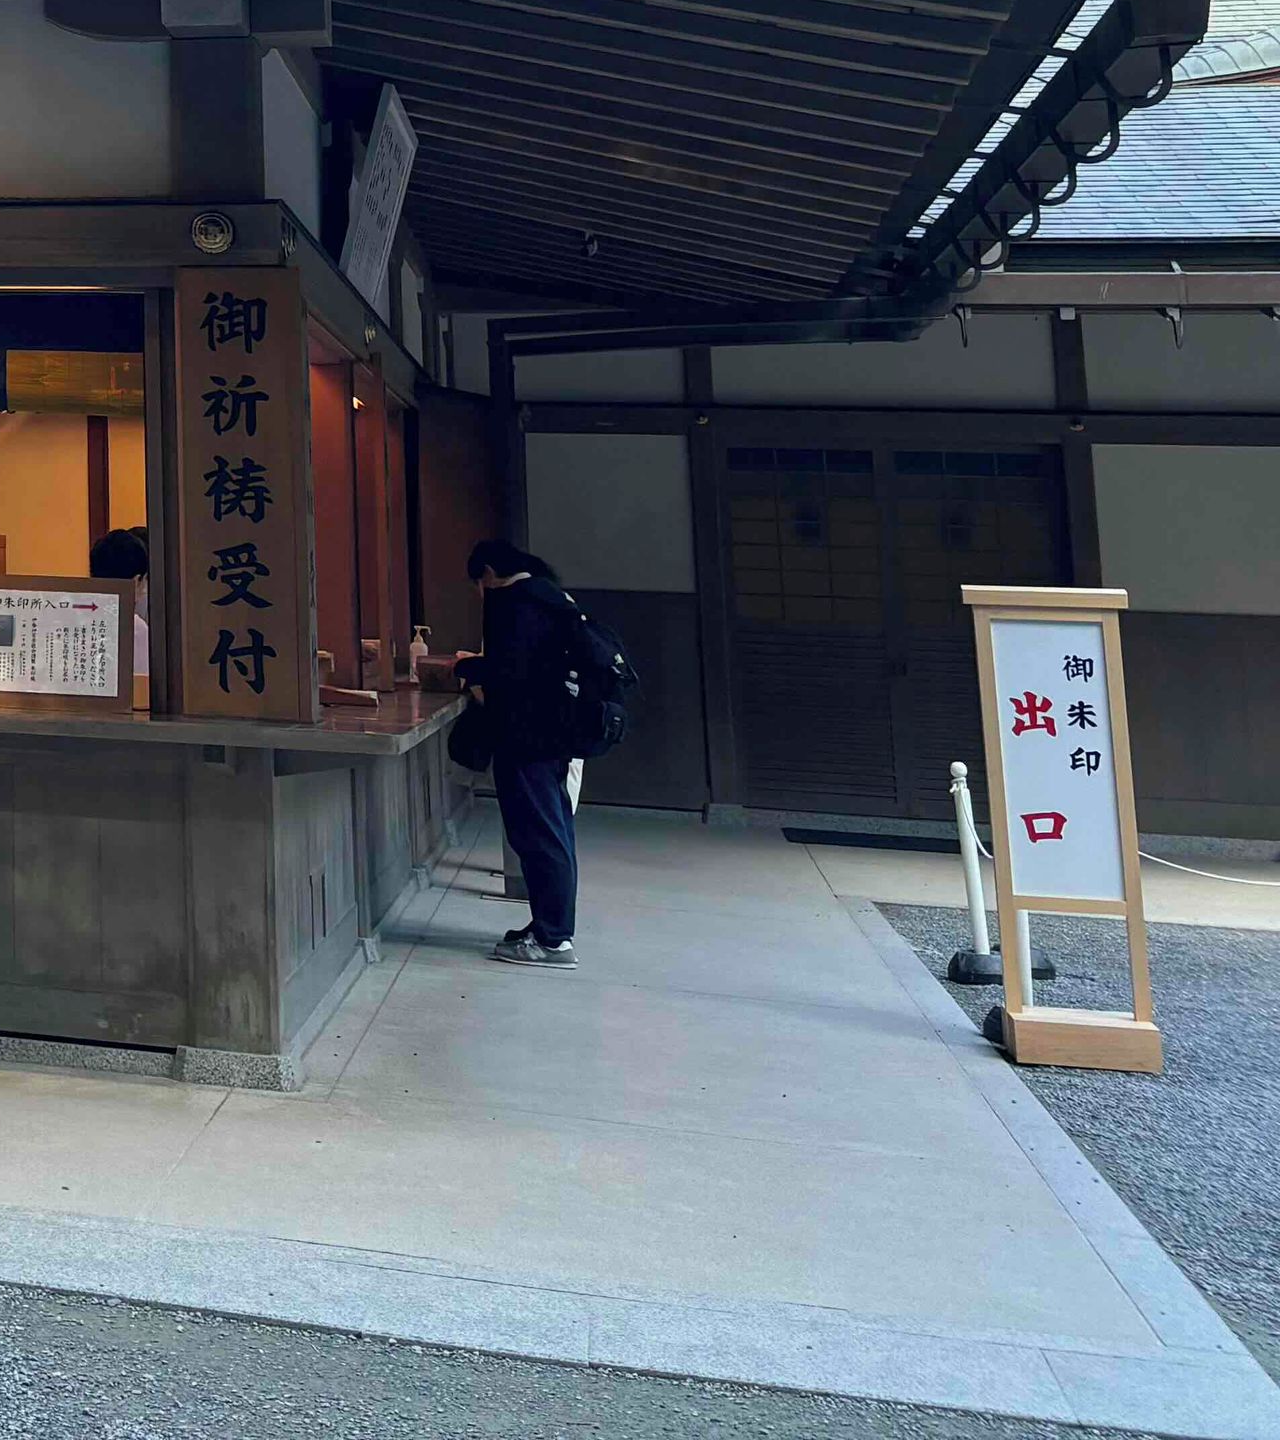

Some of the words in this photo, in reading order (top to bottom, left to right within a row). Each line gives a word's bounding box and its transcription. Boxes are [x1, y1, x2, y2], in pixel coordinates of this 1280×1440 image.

[199, 291, 278, 696] 御祈祷受付
[1009, 691, 1068, 843] 出口
[1062, 655, 1101, 776] 御朱印
